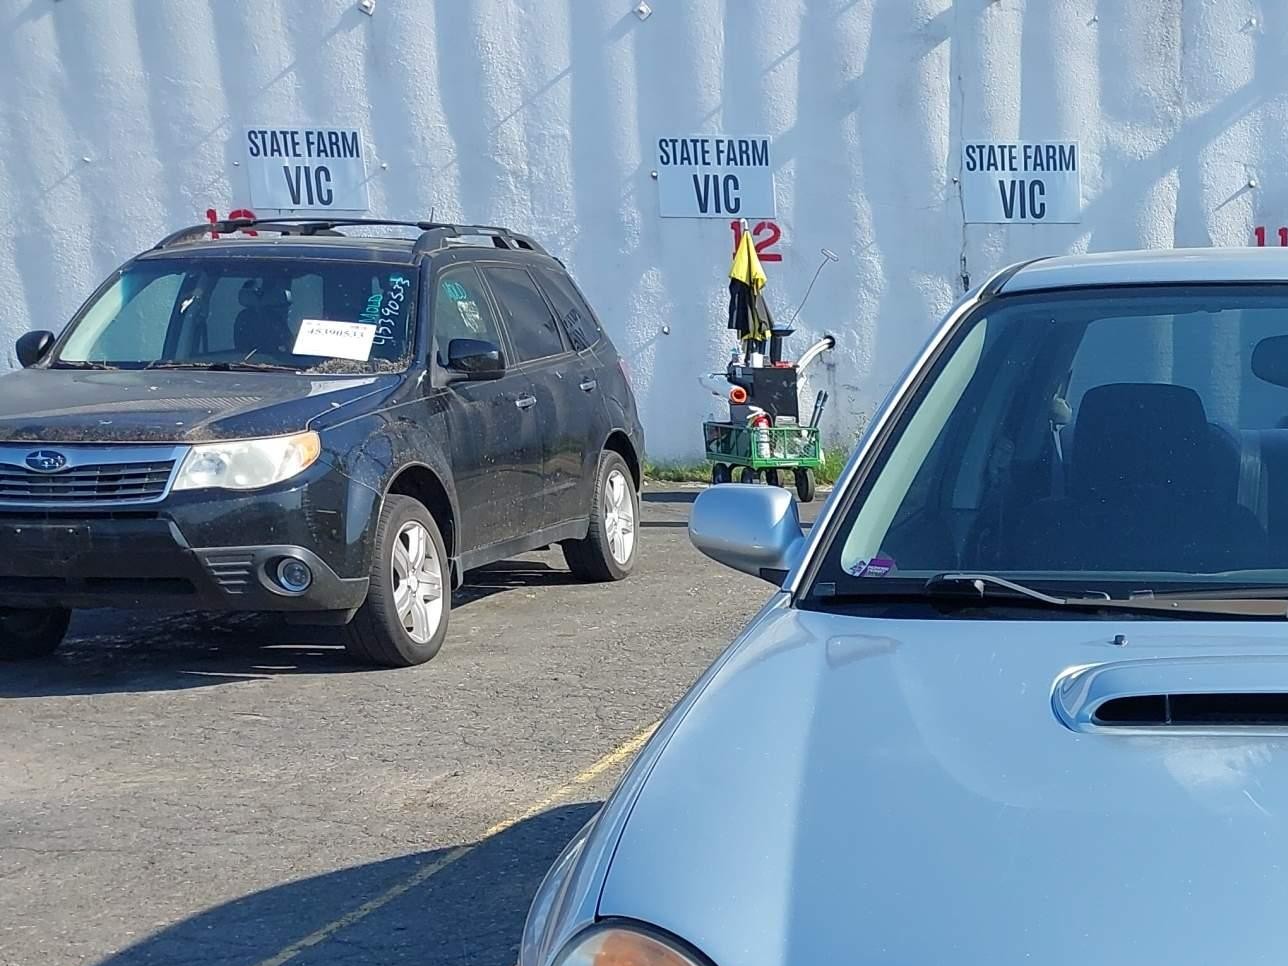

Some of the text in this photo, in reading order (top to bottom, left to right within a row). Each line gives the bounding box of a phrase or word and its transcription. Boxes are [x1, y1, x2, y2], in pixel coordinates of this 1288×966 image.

[247, 130, 360, 158] STATE FARM
[659, 138, 769, 166] STATE FARM
[965, 144, 1076, 171] STATE FARM
[283, 165, 334, 206] VIC
[692, 174, 741, 214] VIC
[998, 179, 1046, 219] VIC
[730, 221, 783, 262] 12
